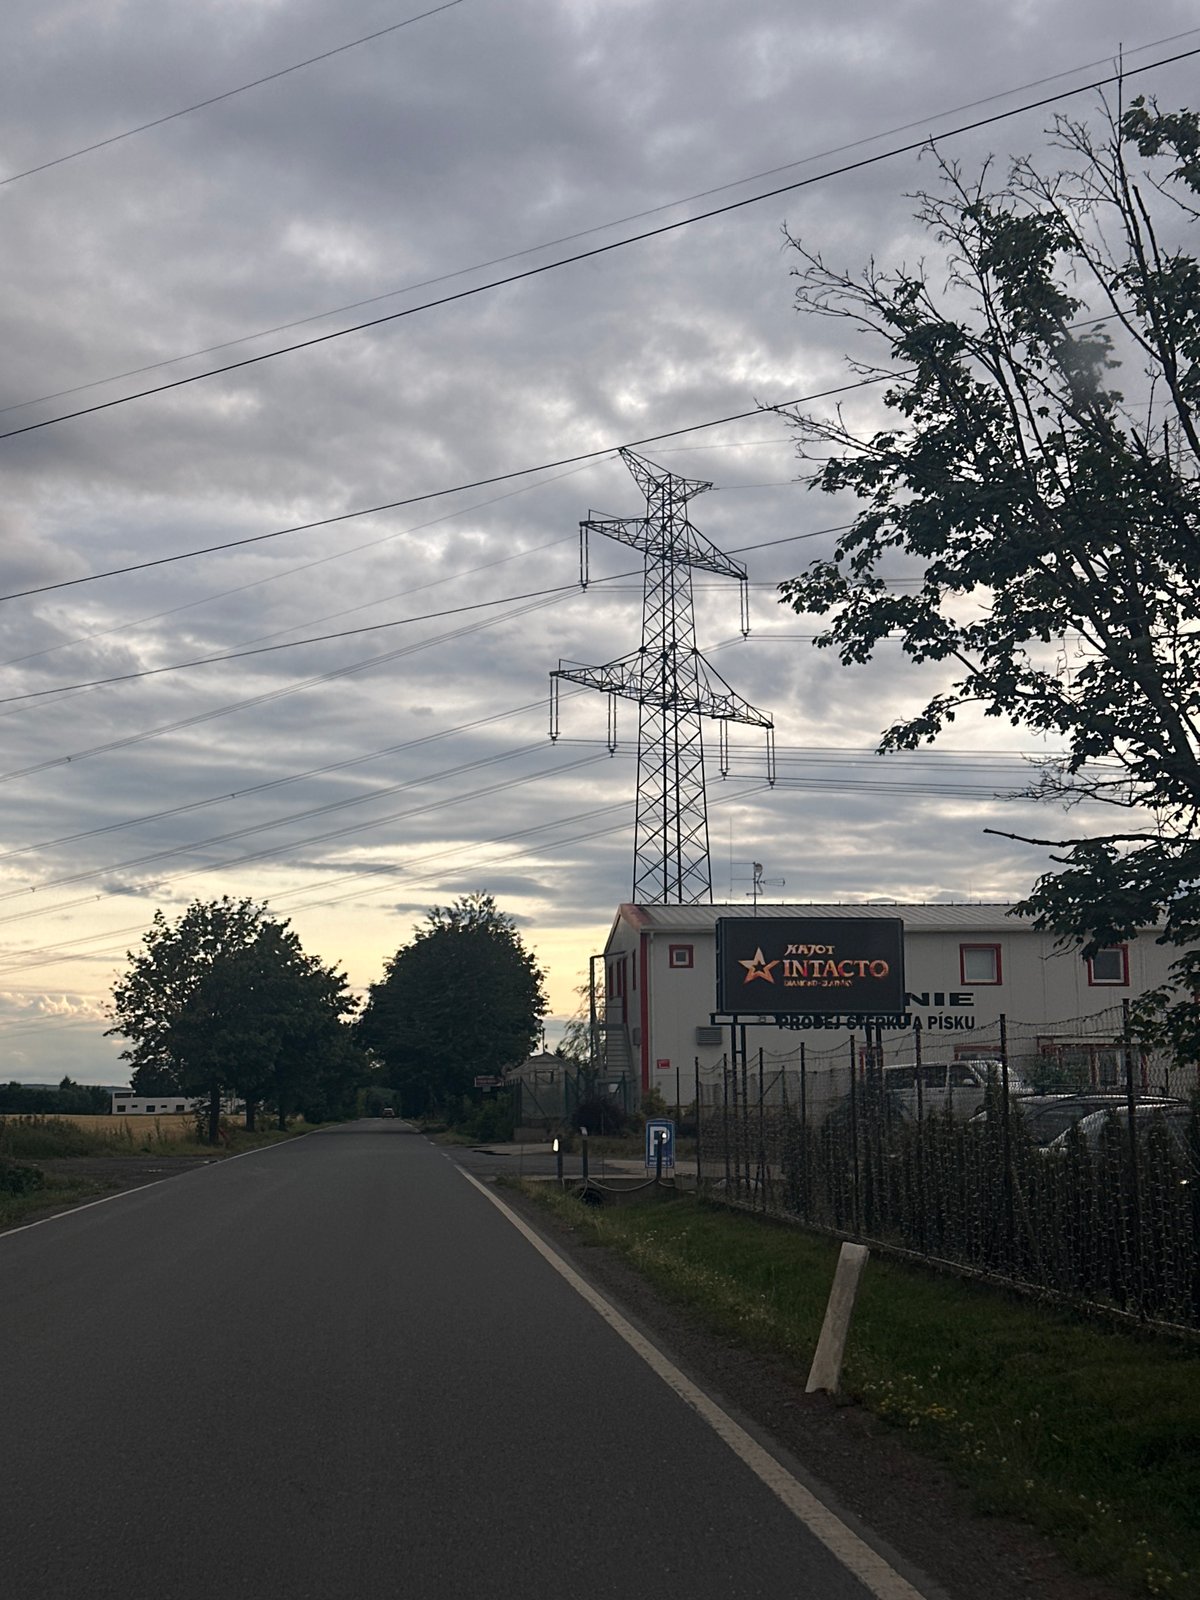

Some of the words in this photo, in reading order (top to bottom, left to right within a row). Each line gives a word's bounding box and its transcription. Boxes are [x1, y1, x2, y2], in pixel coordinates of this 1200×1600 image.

[784, 944, 835, 957] KAJOT
[782, 959, 889, 978] INTACTO
[779, 1015, 840, 1029] PRODEJ
[913, 1015, 923, 1030] A
[927, 1011, 975, 1030] PÍSKU
[649, 1126, 671, 1156] P
